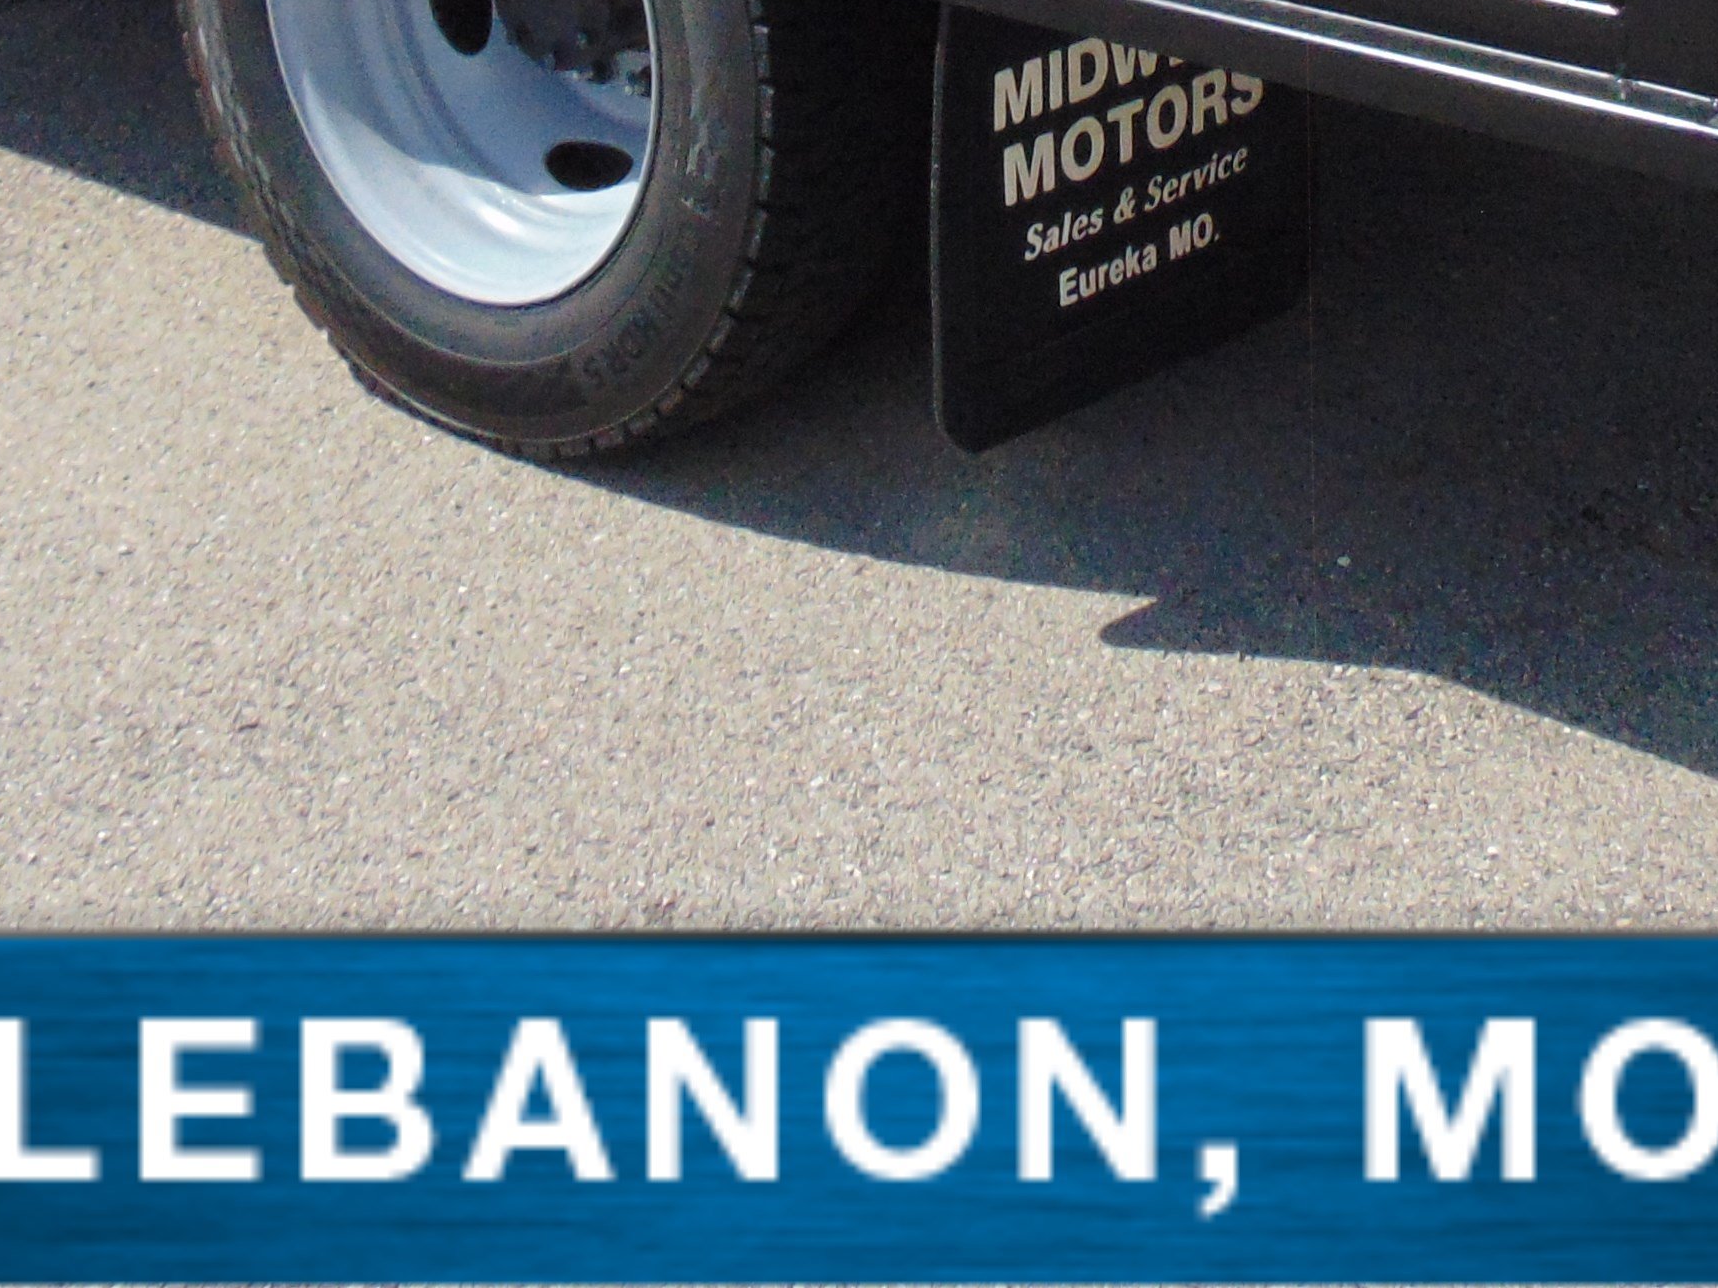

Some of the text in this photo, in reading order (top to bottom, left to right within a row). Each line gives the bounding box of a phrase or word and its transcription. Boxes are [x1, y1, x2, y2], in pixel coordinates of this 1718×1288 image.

[1003, 69, 1263, 207] MOTORS
[1024, 147, 1248, 261] Sales & Service
[1059, 212, 1220, 307] Eureka MO.
